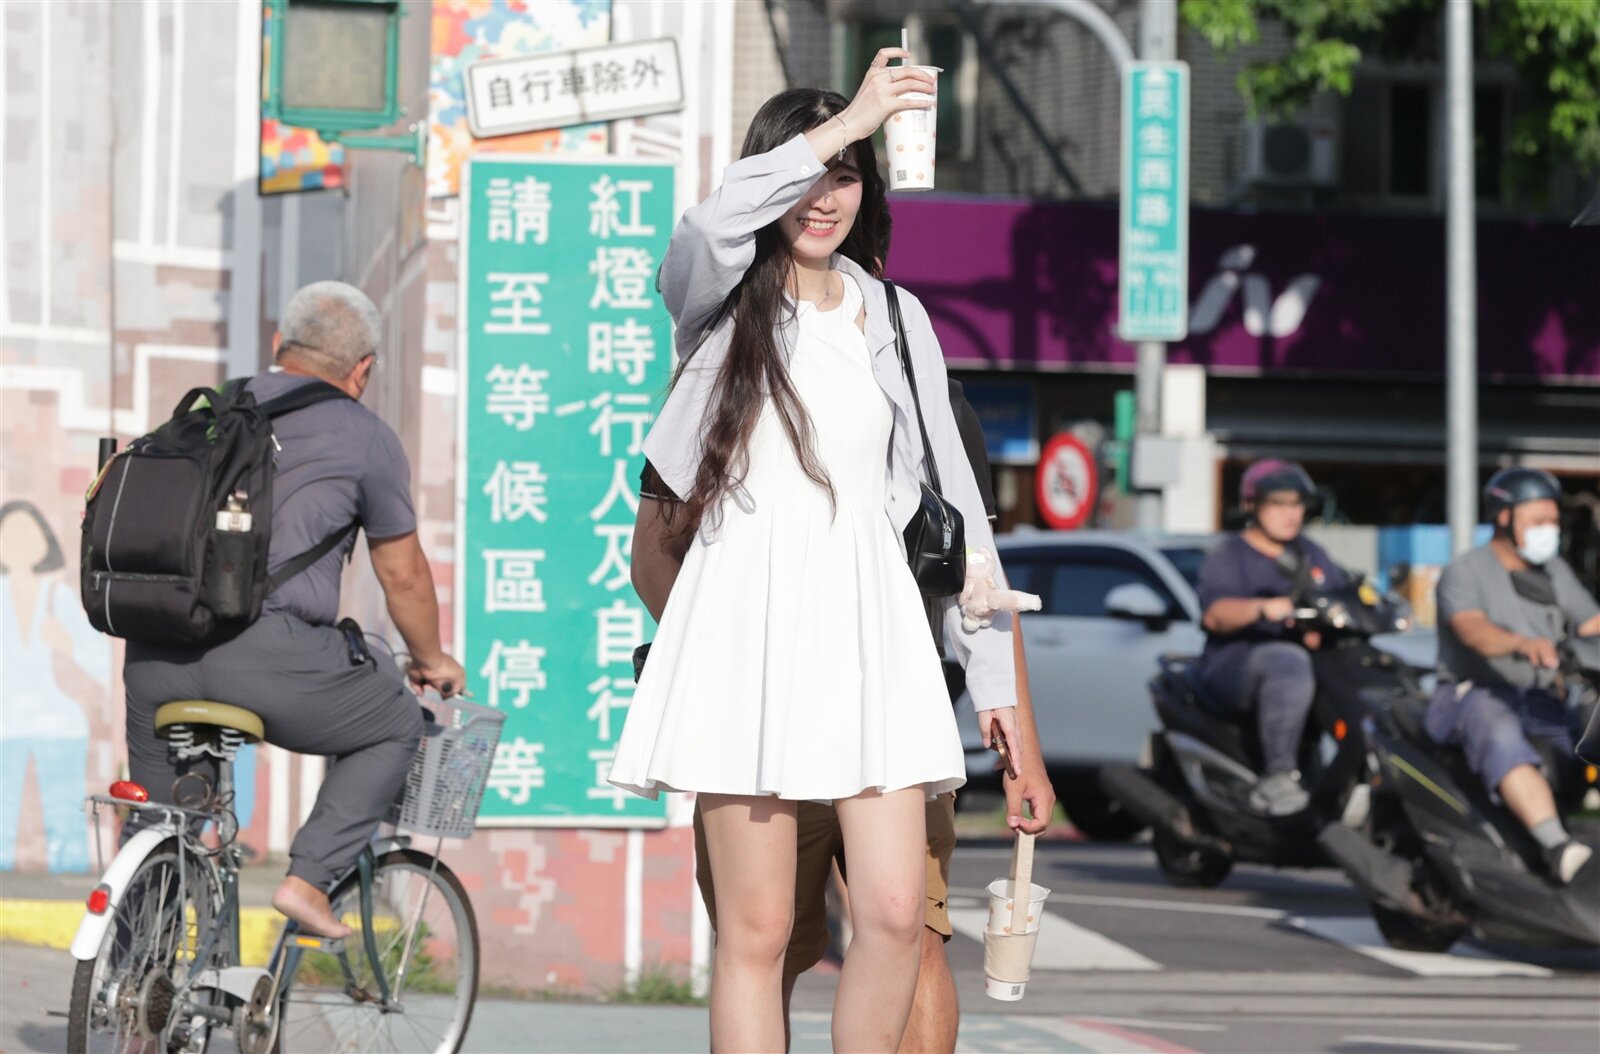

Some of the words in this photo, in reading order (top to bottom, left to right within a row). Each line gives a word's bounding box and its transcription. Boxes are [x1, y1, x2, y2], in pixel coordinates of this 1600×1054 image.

[488, 55, 664, 109] 自行車除外
[1138, 85, 1173, 227] 民生西路
[481, 176, 551, 805] 請至等候區停等
